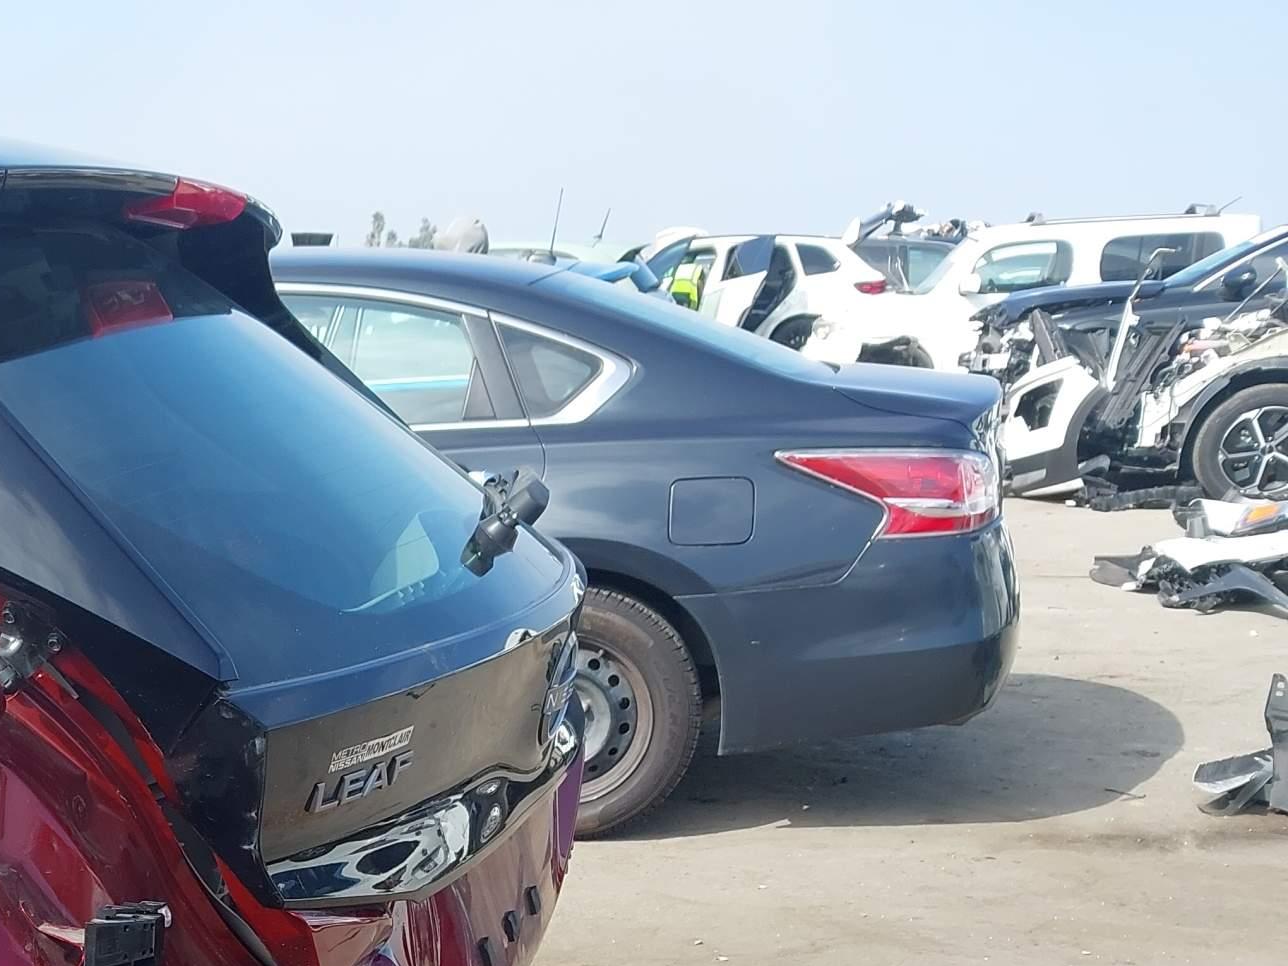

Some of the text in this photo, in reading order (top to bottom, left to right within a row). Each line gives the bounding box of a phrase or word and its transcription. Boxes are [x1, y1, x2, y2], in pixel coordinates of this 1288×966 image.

[331, 743, 369, 761] METRO
[367, 730, 412, 757] MONTCLAIR
[328, 753, 367, 774] NISSAN
[305, 749, 414, 813] LEAF
